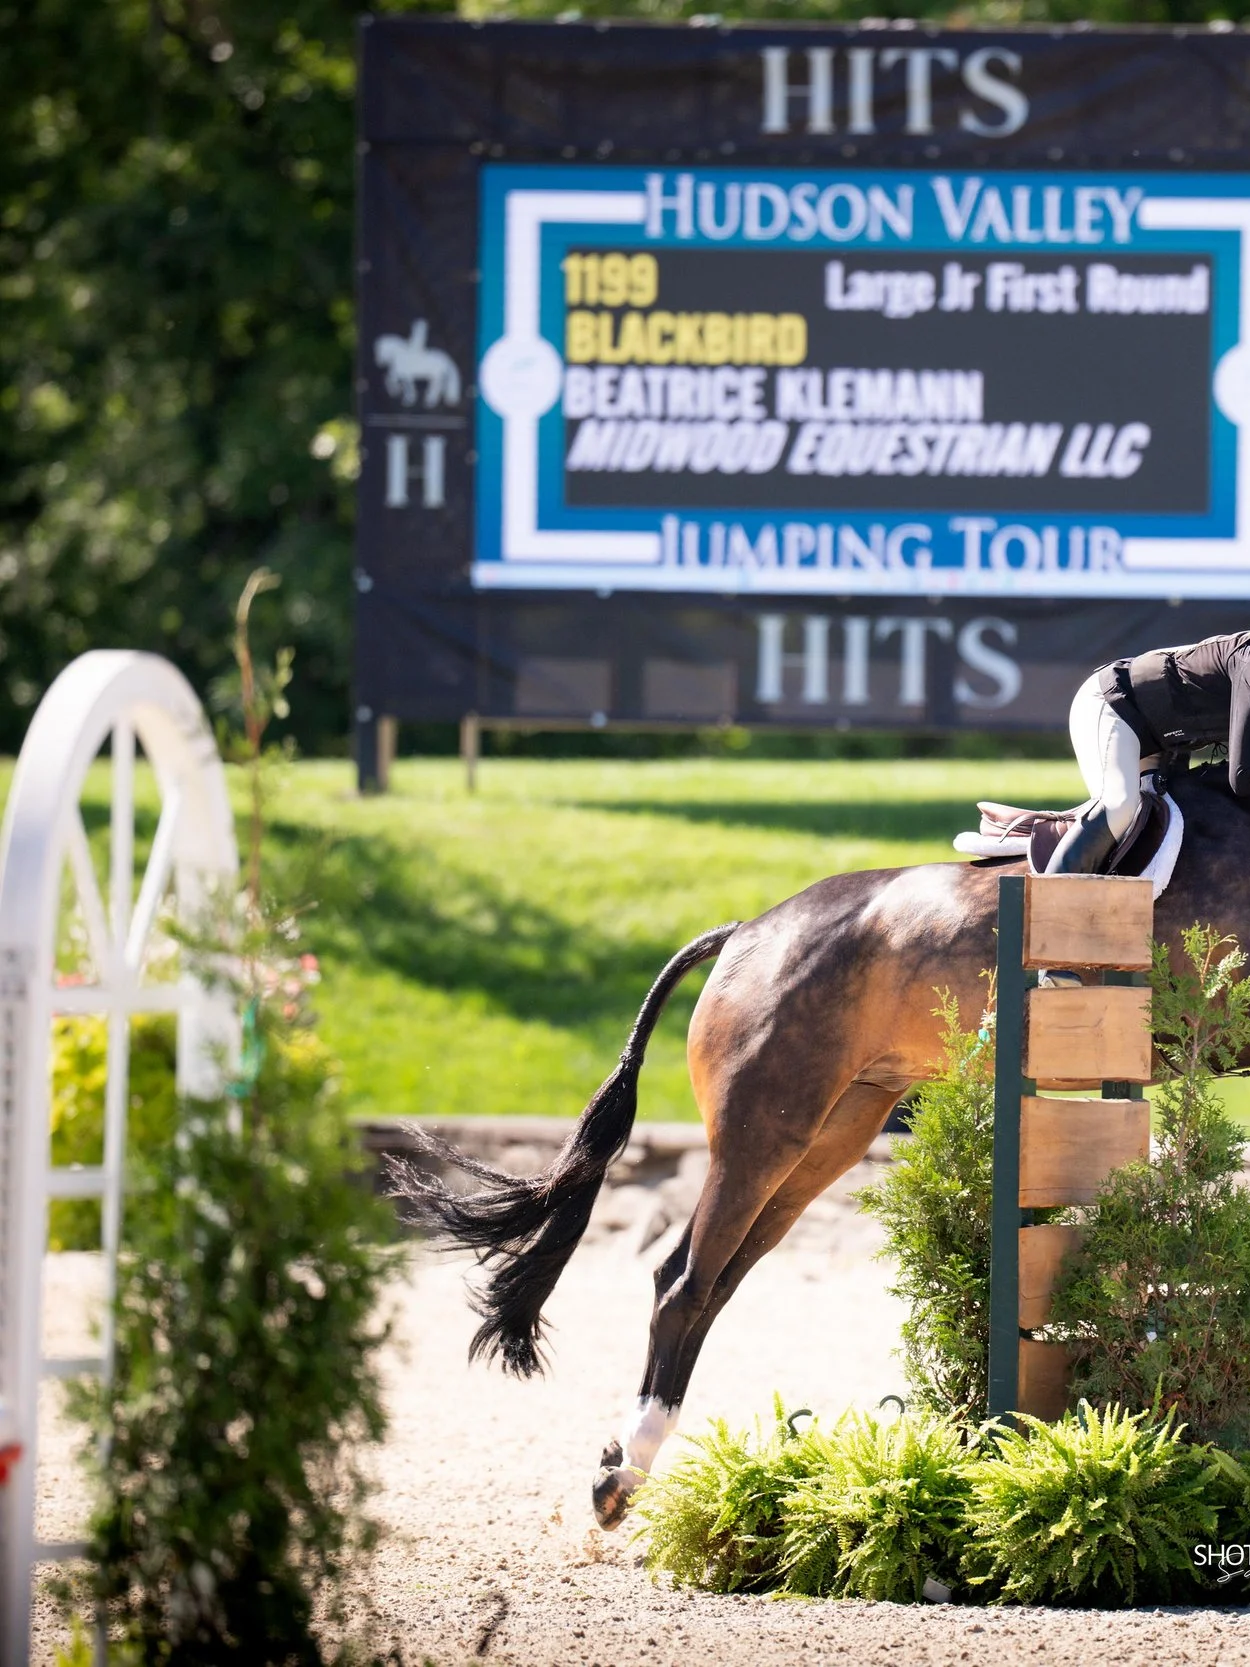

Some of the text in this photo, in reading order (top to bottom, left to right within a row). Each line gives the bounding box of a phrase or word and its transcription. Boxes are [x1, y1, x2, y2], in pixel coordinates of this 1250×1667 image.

[760, 46, 1030, 138] HITS
[644, 173, 1144, 244] HUDSON VALLEY
[563, 252, 659, 308] 1199
[824, 260, 1210, 319] Large Jr First Round
[565, 311, 808, 367] BLACKBIRD
[563, 367, 984, 422] BEATRICE KLEMANN
[566, 419, 1151, 479] MIDWOOD EQUESTRIAN LLC
[661, 513, 1124, 573] JUMPING TOUR
[756, 614, 1022, 709] HITS
